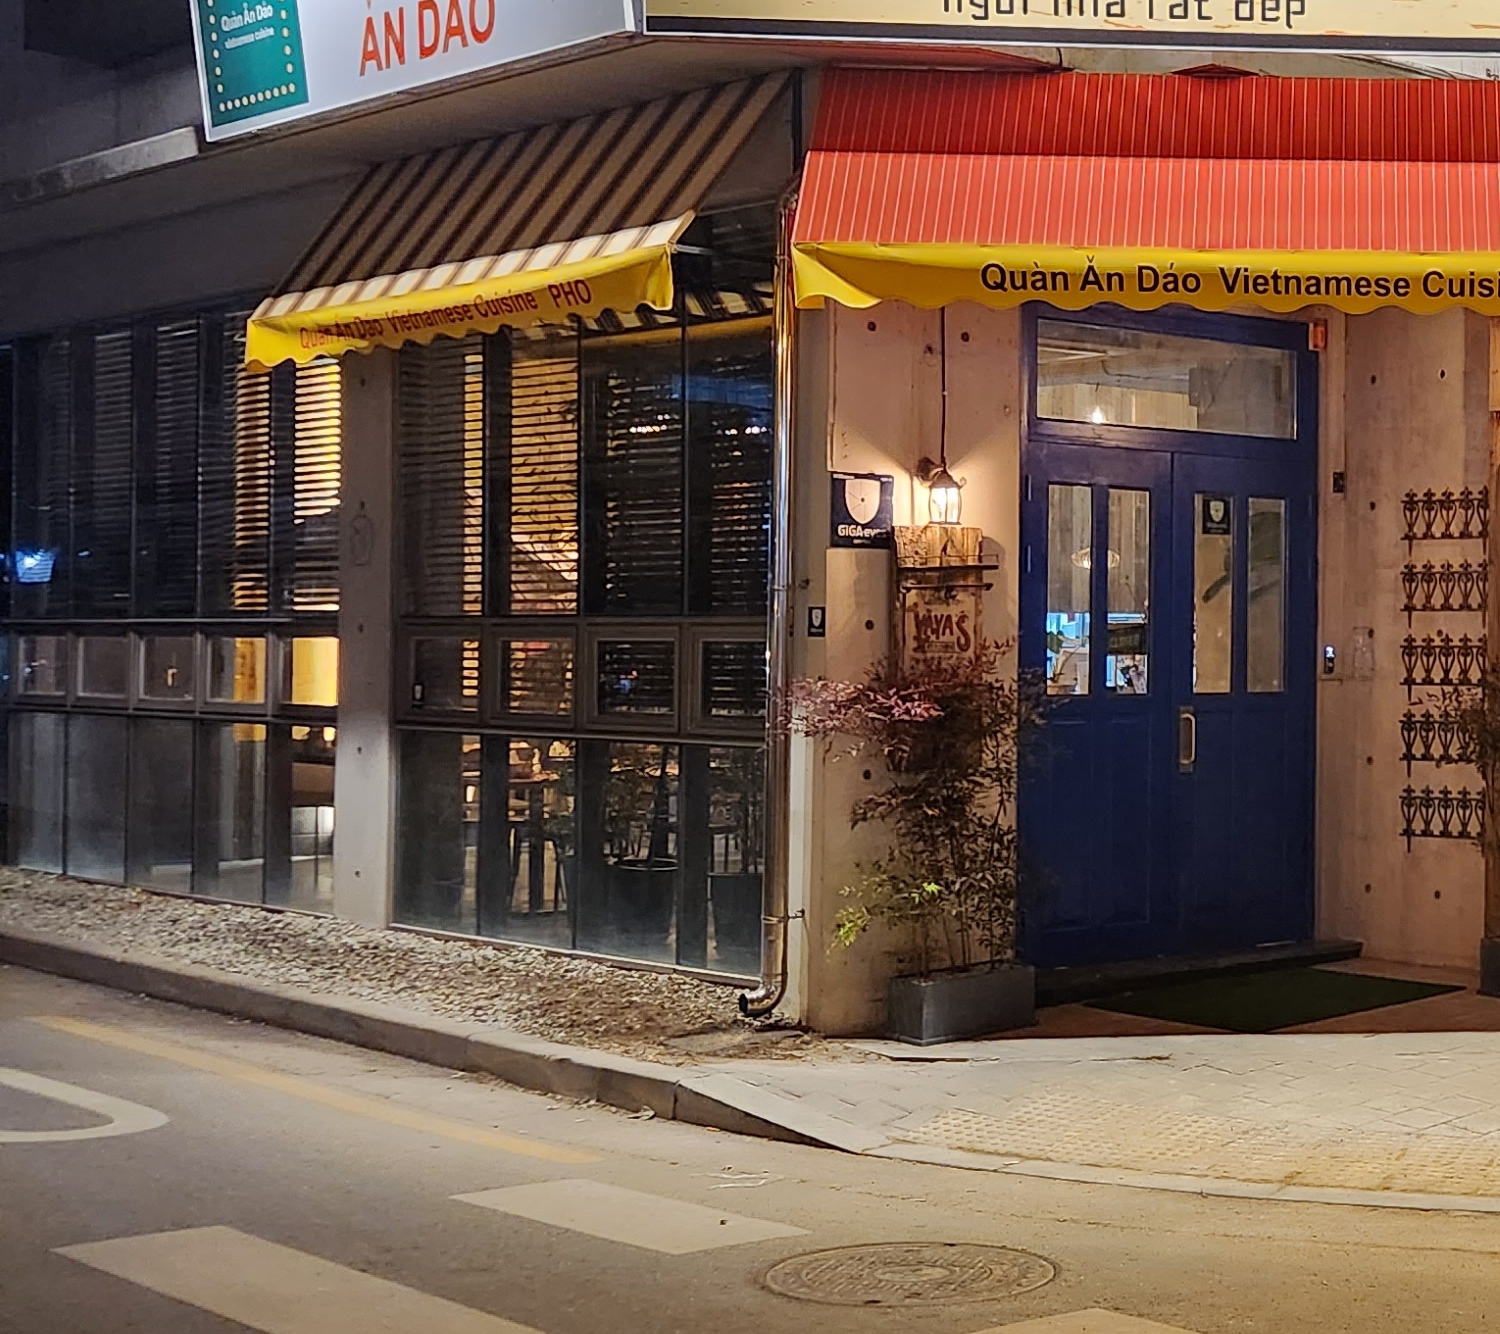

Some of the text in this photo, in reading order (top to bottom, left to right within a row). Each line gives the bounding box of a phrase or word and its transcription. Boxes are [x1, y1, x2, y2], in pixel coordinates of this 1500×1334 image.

[1136, 262, 1201, 294] Dáo
[1218, 266, 1411, 298] Vietnamese
[385, 302, 473, 334] Vietnamese
[473, 289, 538, 319] Cuisine
[547, 279, 592, 308] PHO
